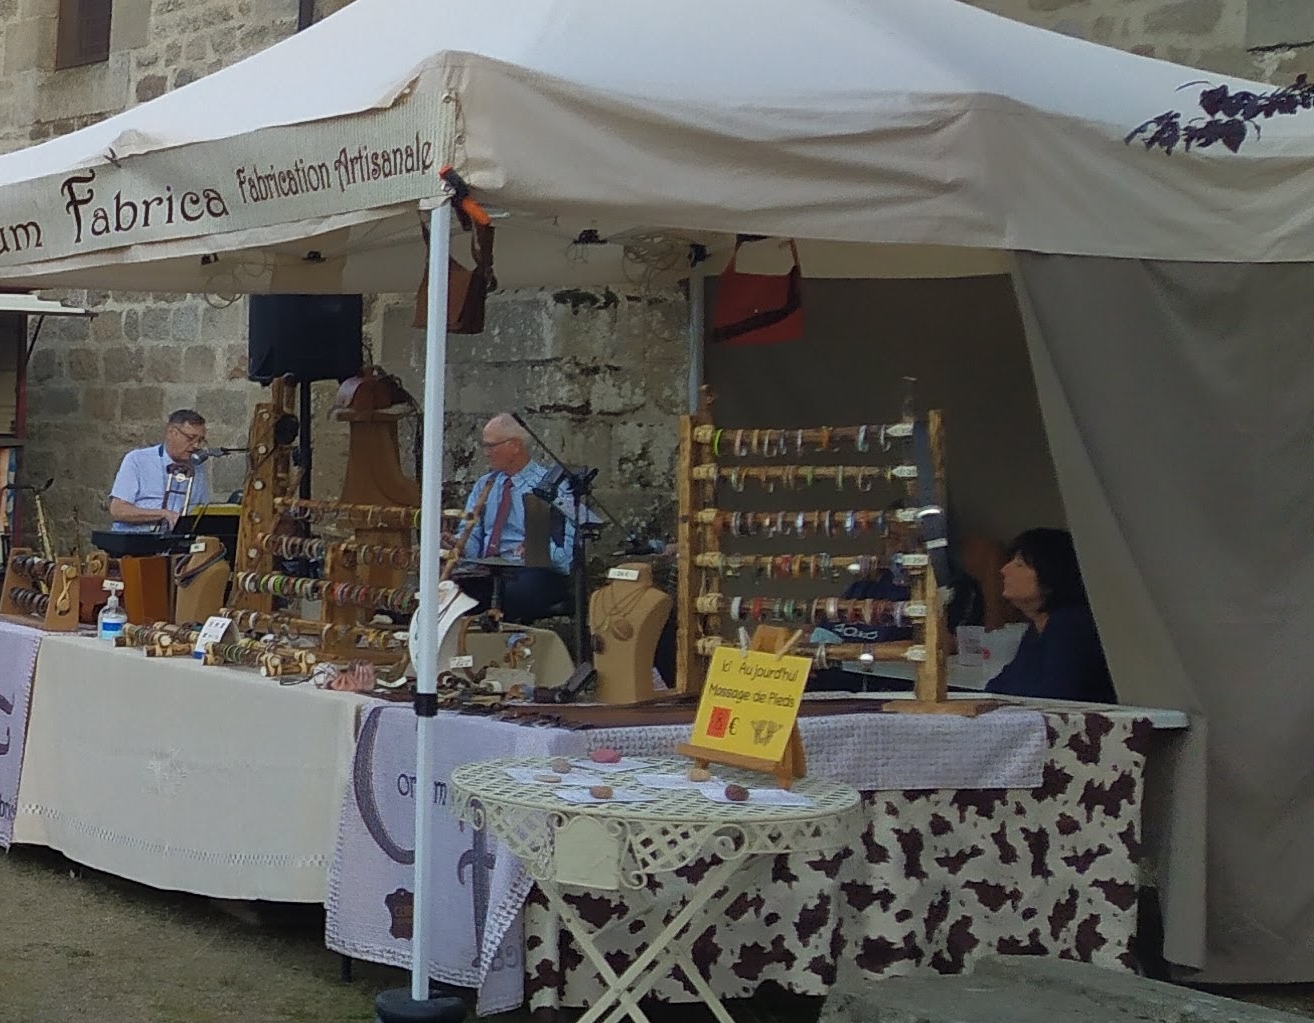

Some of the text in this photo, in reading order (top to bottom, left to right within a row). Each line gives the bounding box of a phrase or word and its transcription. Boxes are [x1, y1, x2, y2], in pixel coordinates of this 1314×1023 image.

[236, 132, 435, 205] Fabrication Artisanale
[61, 169, 229, 243] Fabrica
[710, 684, 795, 708] Massage de Pieds
